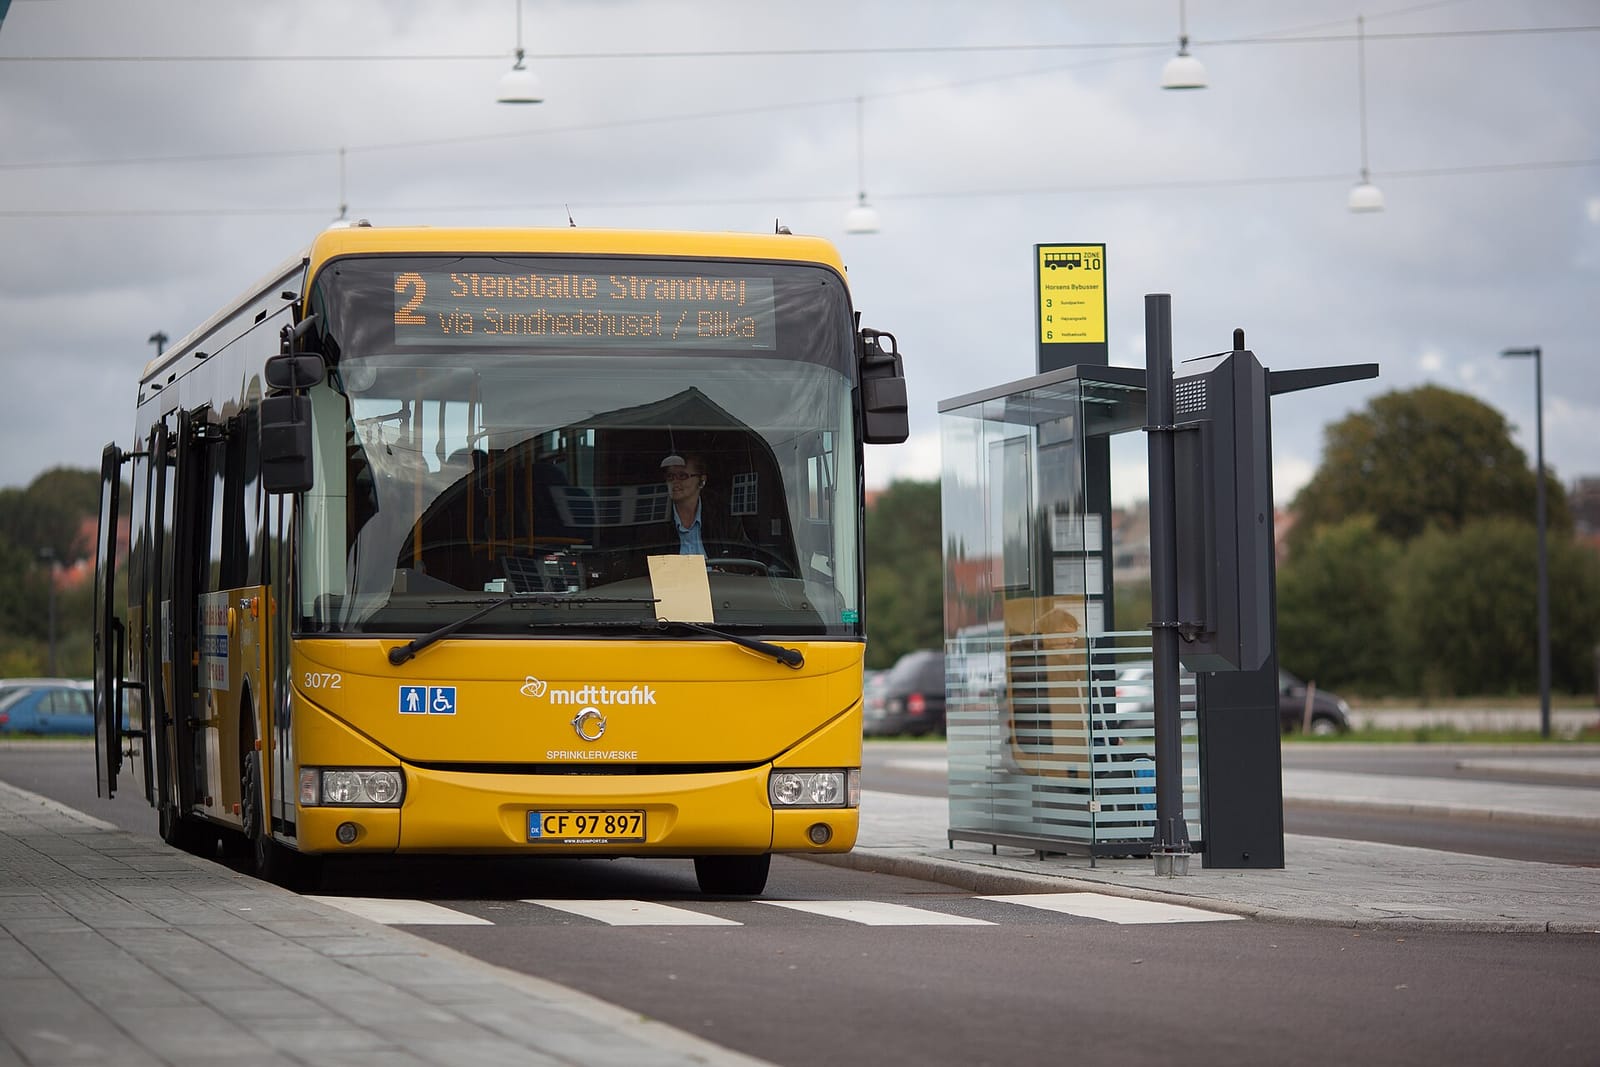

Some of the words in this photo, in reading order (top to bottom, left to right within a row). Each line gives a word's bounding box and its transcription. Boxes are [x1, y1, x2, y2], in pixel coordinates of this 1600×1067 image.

[1084, 259, 1100, 270] 10
[450, 272, 598, 299] Stensballe
[609, 274, 746, 306] Strandvej
[394, 272, 427, 325] 2
[1046, 299, 1052, 307] 3
[439, 307, 474, 335] via
[483, 307, 663, 337] Sundhedshuset
[671, 310, 688, 340] /
[697, 310, 756, 338] Bilka
[1046, 315, 1052, 323] 4
[1046, 331, 1053, 339] 6
[304, 672, 343, 689] 3072
[549, 684, 657, 705] midttrafik
[546, 750, 638, 760] SPRINKLERVÆSKE
[543, 815, 569, 834] CF
[575, 815, 599, 834] 97
[604, 815, 641, 834] 897
